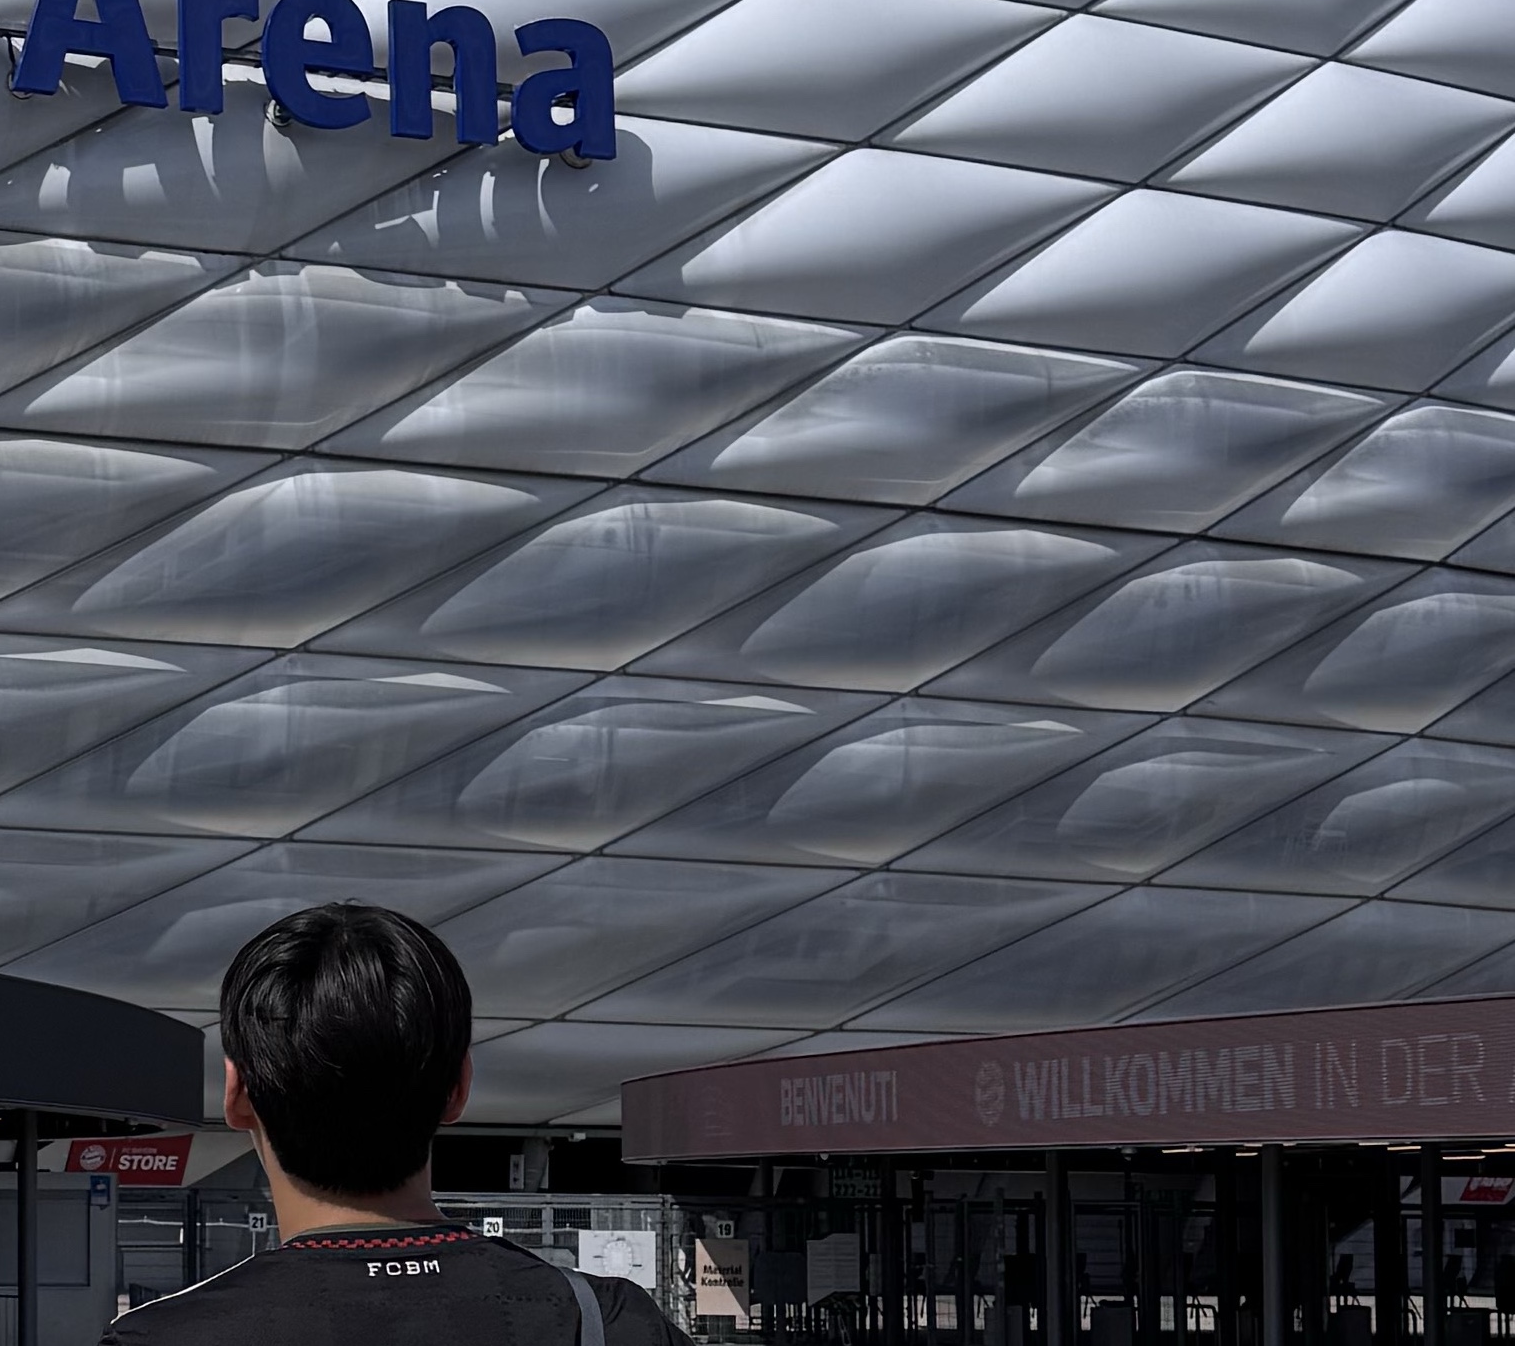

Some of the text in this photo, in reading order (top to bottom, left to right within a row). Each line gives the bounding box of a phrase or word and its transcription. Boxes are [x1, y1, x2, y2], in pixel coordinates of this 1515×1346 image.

[1014, 1032, 1485, 1121] WILLKOMMEN IN DER
[781, 1070, 898, 1127] BENVENUTI
[118, 1154, 179, 1171] STORE
[250, 1217, 264, 1229] 21
[486, 1222, 500, 1233] 20
[718, 1224, 732, 1236] 19
[367, 1260, 440, 1276] FCBM
